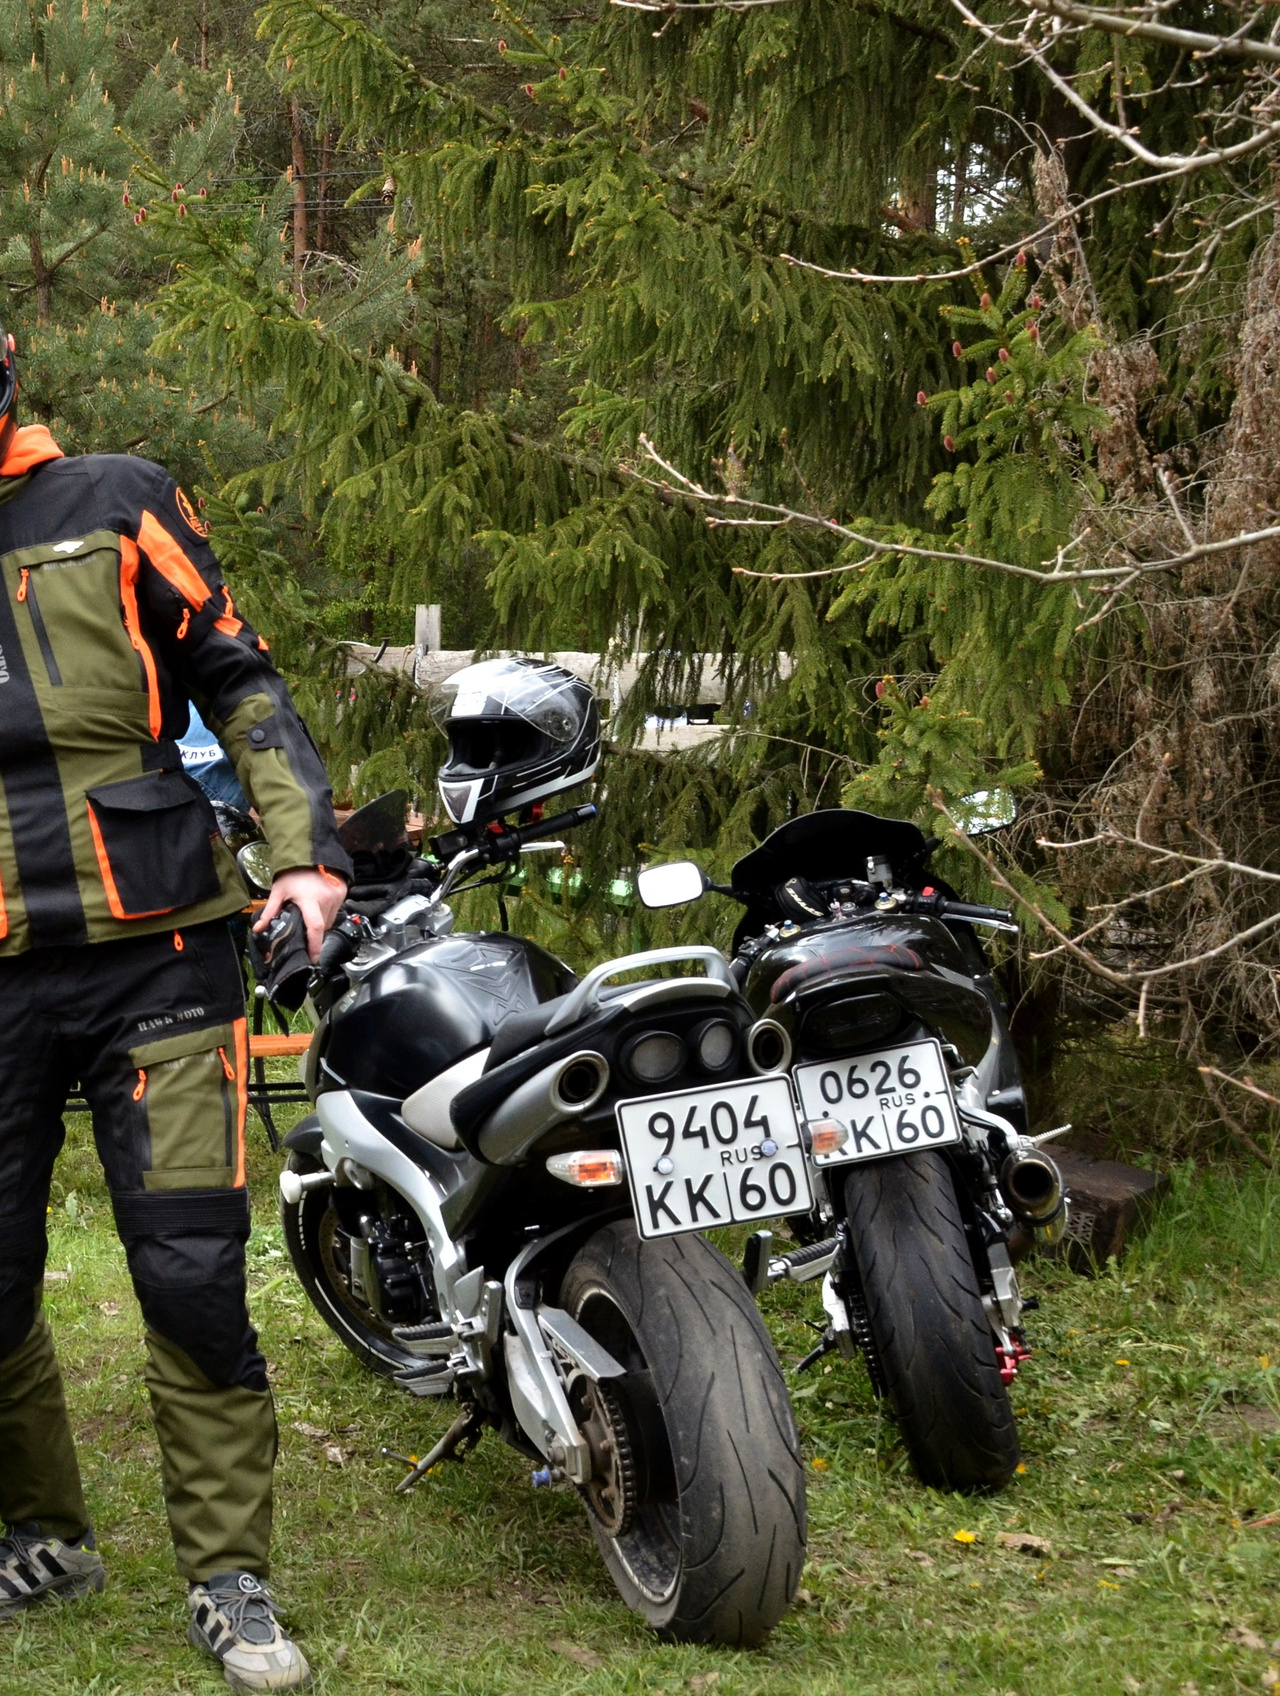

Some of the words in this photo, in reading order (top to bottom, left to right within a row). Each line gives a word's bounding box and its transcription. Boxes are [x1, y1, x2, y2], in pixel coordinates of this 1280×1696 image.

[819, 1054, 922, 1105] 0626
[879, 1092, 917, 1111] RUS
[647, 1094, 772, 1156] 9404
[822, 1115, 882, 1160] K
[896, 1104, 945, 1144] 60
[720, 1144, 764, 1167] RUS
[739, 1161, 797, 1212] 60
